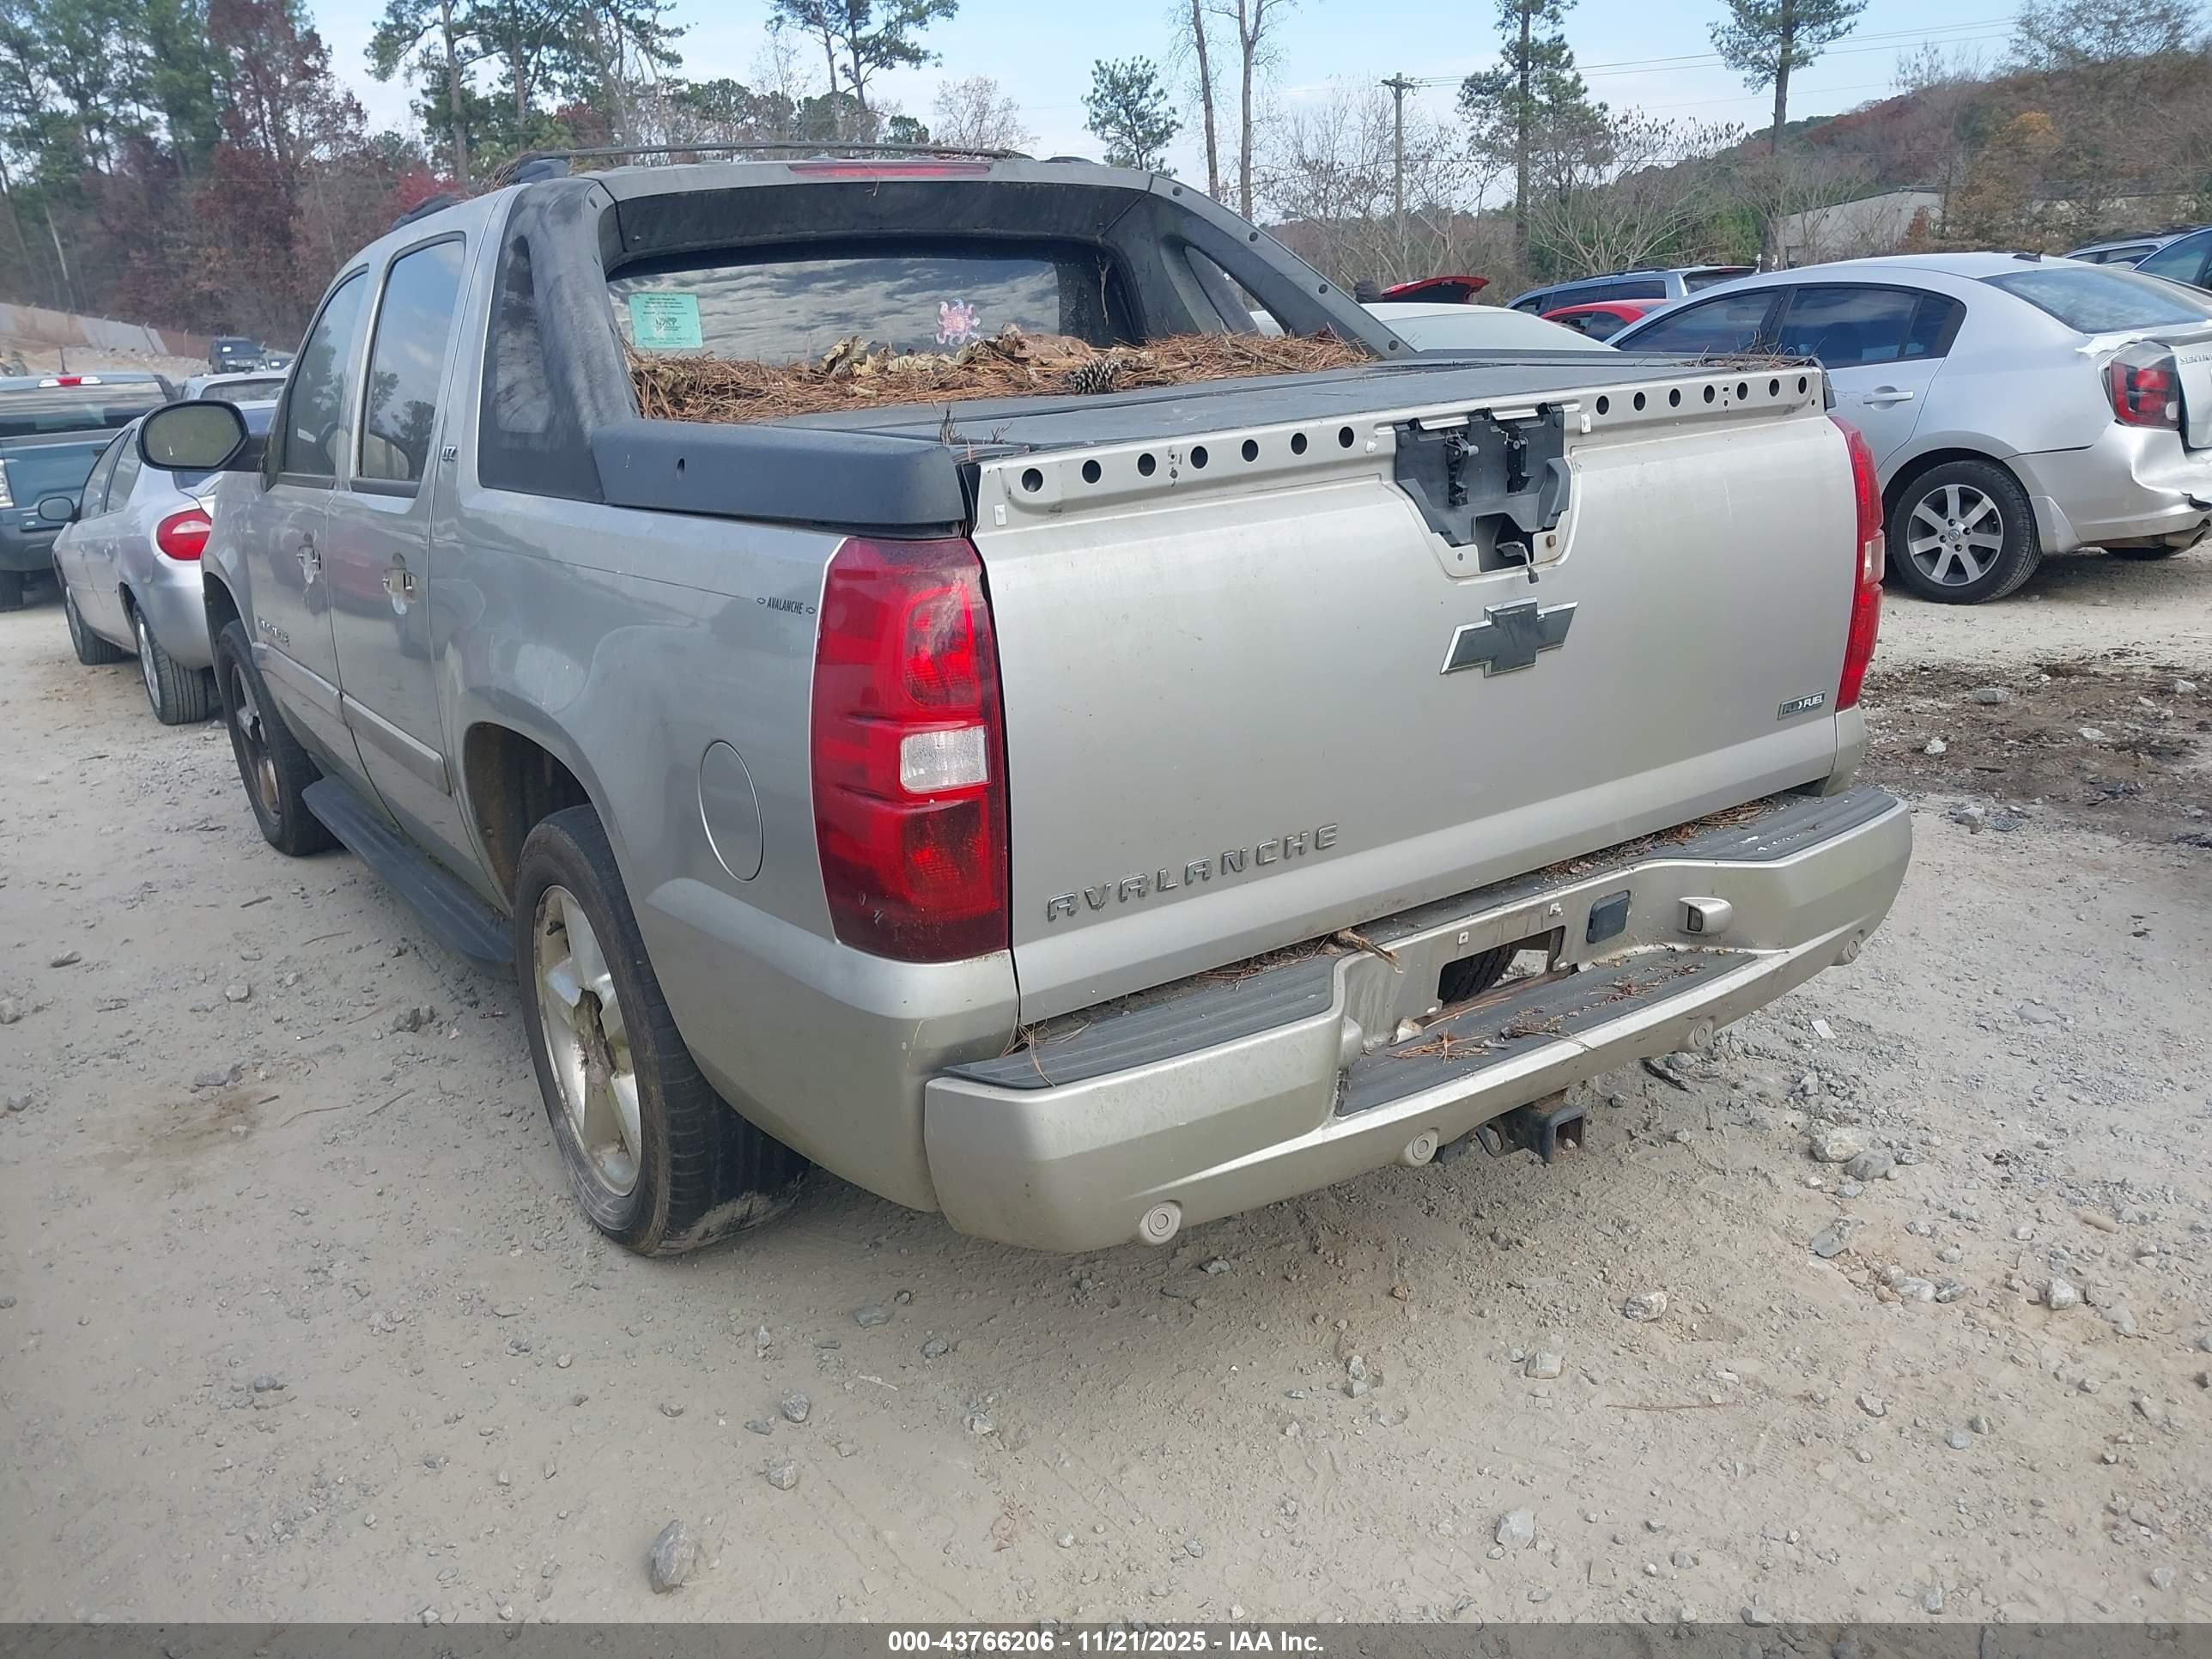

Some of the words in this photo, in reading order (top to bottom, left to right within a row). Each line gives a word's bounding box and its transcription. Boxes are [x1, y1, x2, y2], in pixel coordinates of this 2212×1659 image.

[2180, 352, 2212, 365] SENTR
[767, 597, 804, 615] AVALANCHE
[1046, 823, 1339, 922] AVALANCHE
